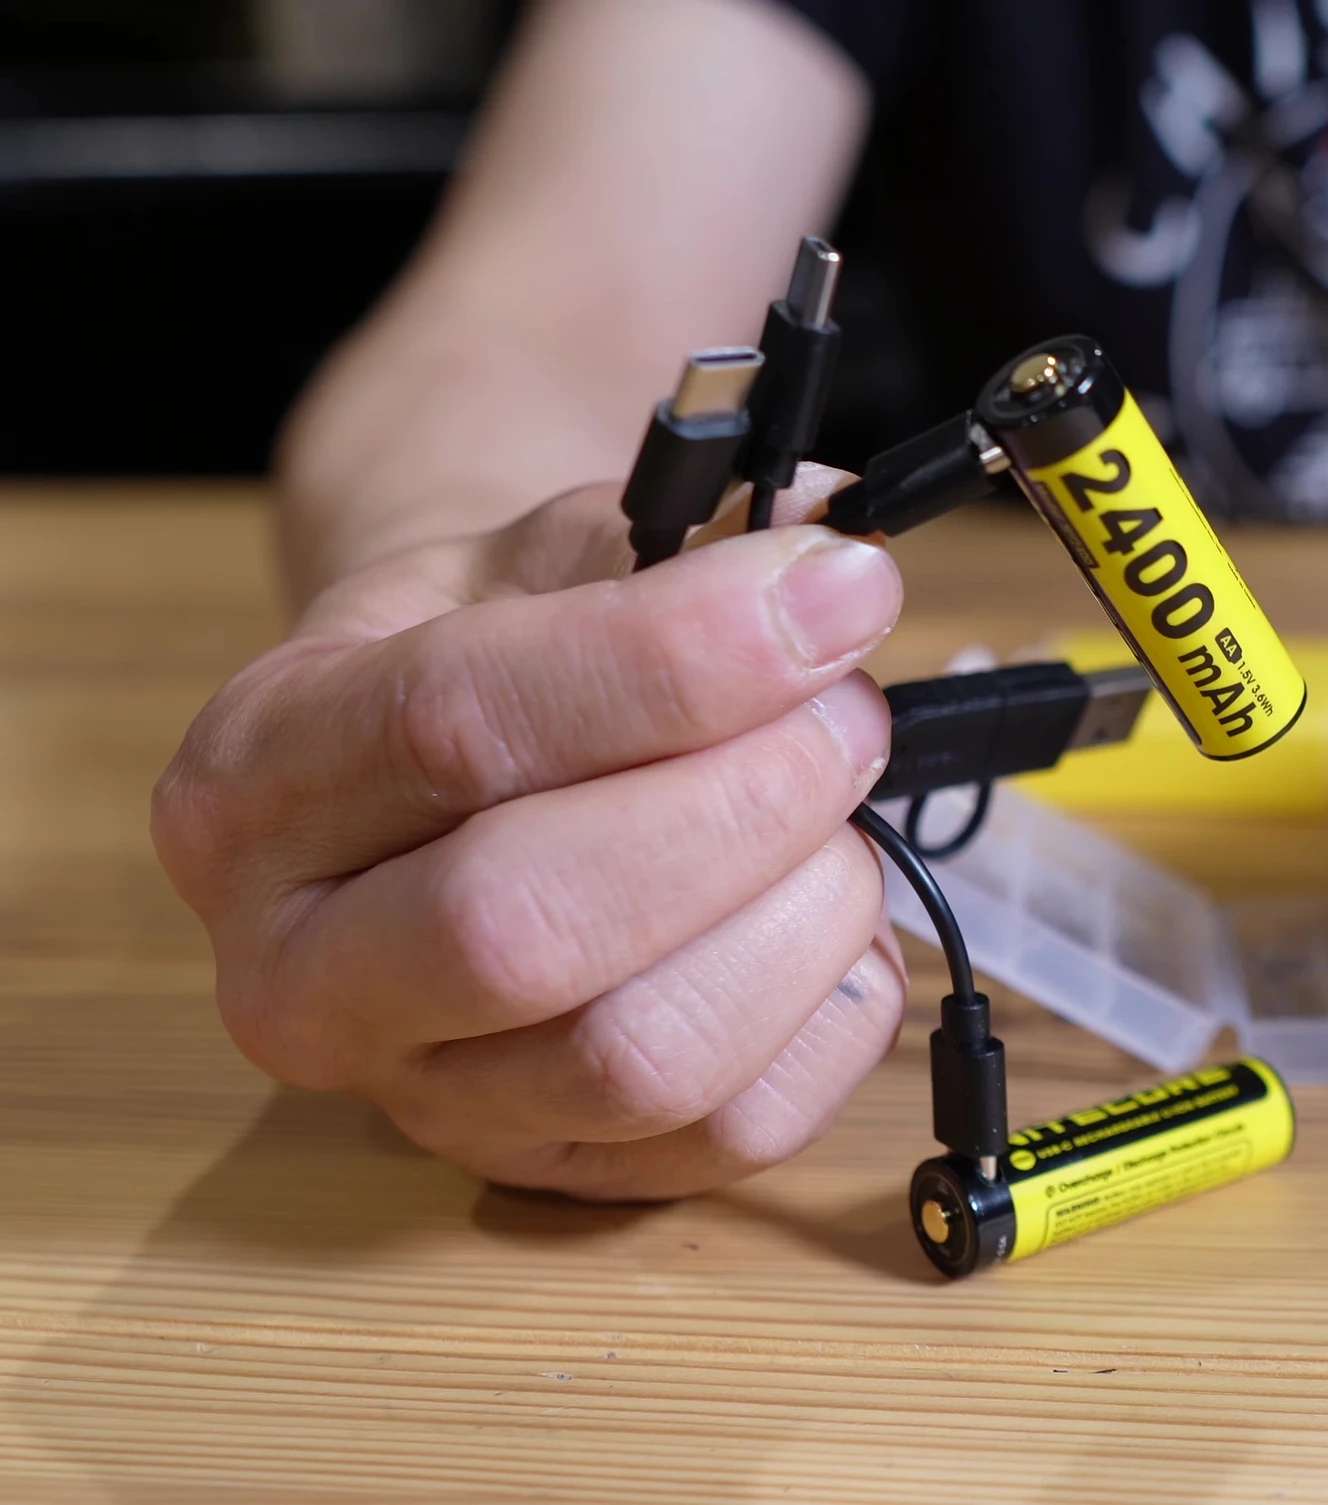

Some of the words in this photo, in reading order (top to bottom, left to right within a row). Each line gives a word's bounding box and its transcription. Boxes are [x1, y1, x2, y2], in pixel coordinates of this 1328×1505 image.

[1060, 448, 1214, 639] 2400
[1177, 645, 1256, 738] mAh
[1219, 634, 1238, 658] AA
[1237, 661, 1256, 685] 1.5V
[1251, 684, 1274, 717] 3.6Wh
